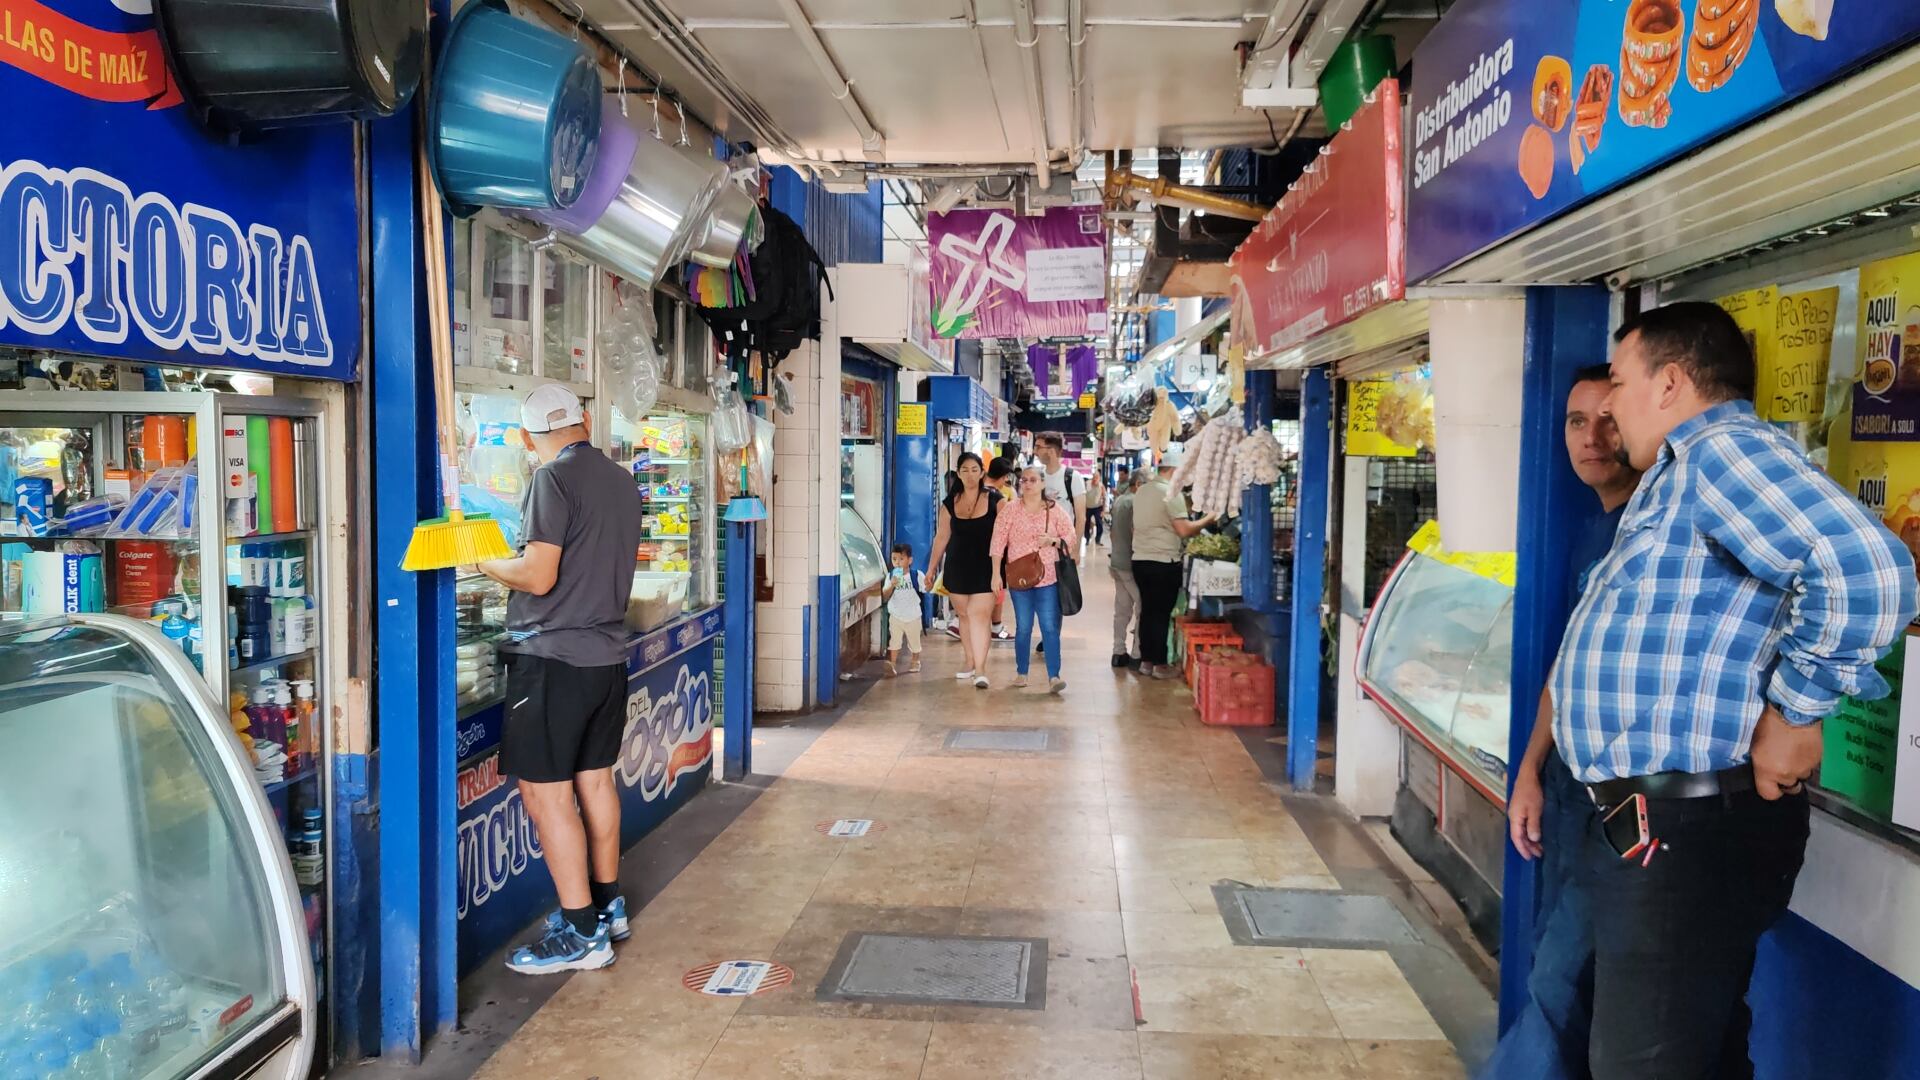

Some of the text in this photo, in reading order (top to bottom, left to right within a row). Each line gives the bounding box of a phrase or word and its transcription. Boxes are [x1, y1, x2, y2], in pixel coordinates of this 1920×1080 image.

[0, 10, 148, 85] LAS DE MAÍZ
[1415, 38, 1514, 149] Distribuidora
[1414, 85, 1512, 189] San Antonio
[1866, 291, 1897, 328] AQUÍ
[1868, 330, 1893, 358] HAY
[1891, 420, 1896, 433] A
[1897, 419, 1915, 434] SOLO
[228, 457, 245, 467] VISA
[1857, 475, 1887, 508] AQUÍ
[66, 558, 78, 585] dent
[118, 551, 154, 560] Colgate
[630, 697, 649, 721] DEL
[620, 672, 709, 793] ogón
[457, 757, 507, 808] TRAM
